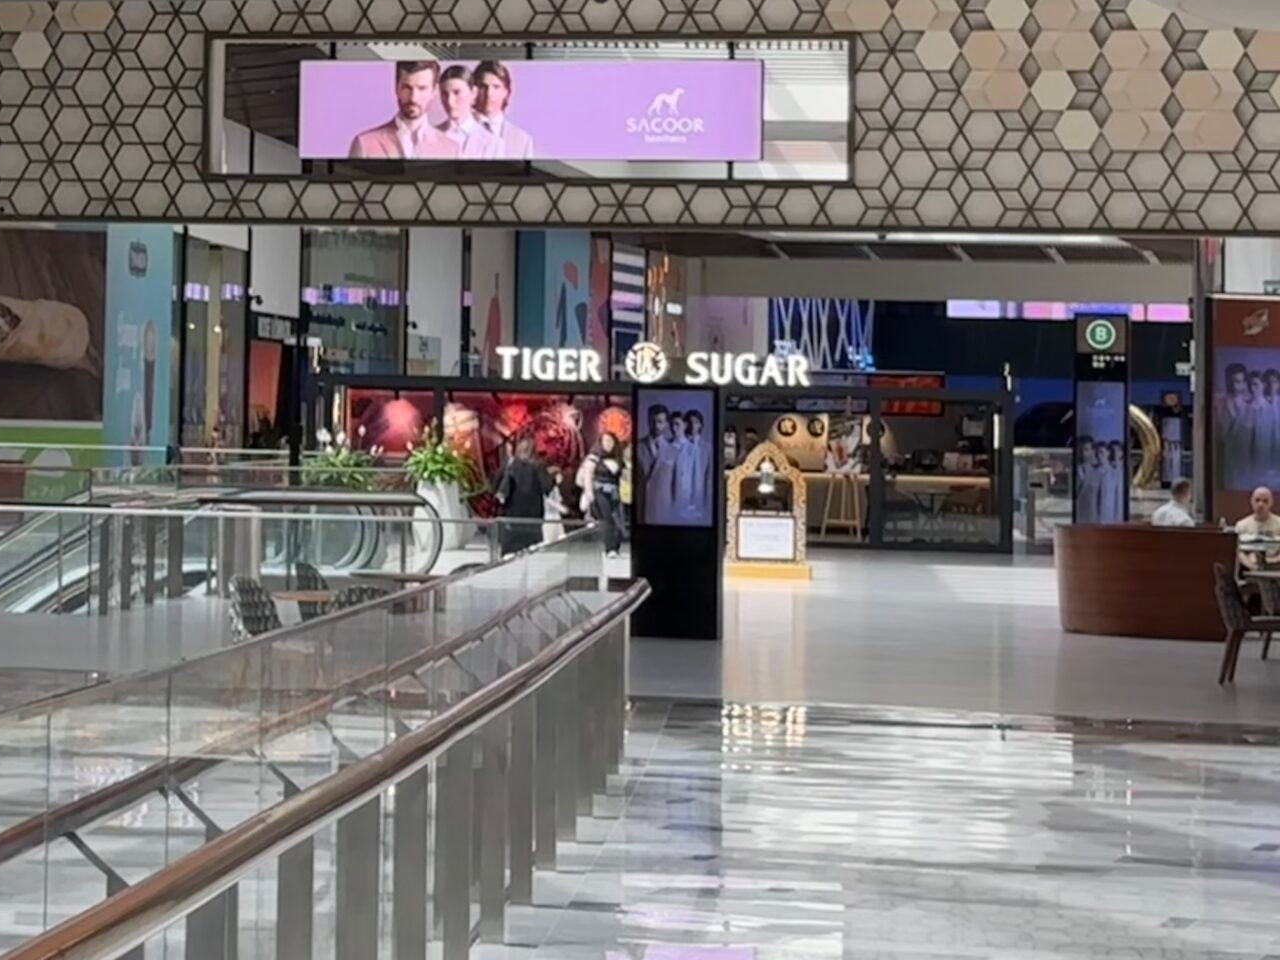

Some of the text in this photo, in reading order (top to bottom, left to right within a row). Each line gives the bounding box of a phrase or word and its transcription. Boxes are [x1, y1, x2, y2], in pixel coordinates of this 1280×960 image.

[626, 117, 705, 133] SACOOR
[1095, 326, 1108, 342] B
[495, 346, 811, 387] TIGER SUGAR
